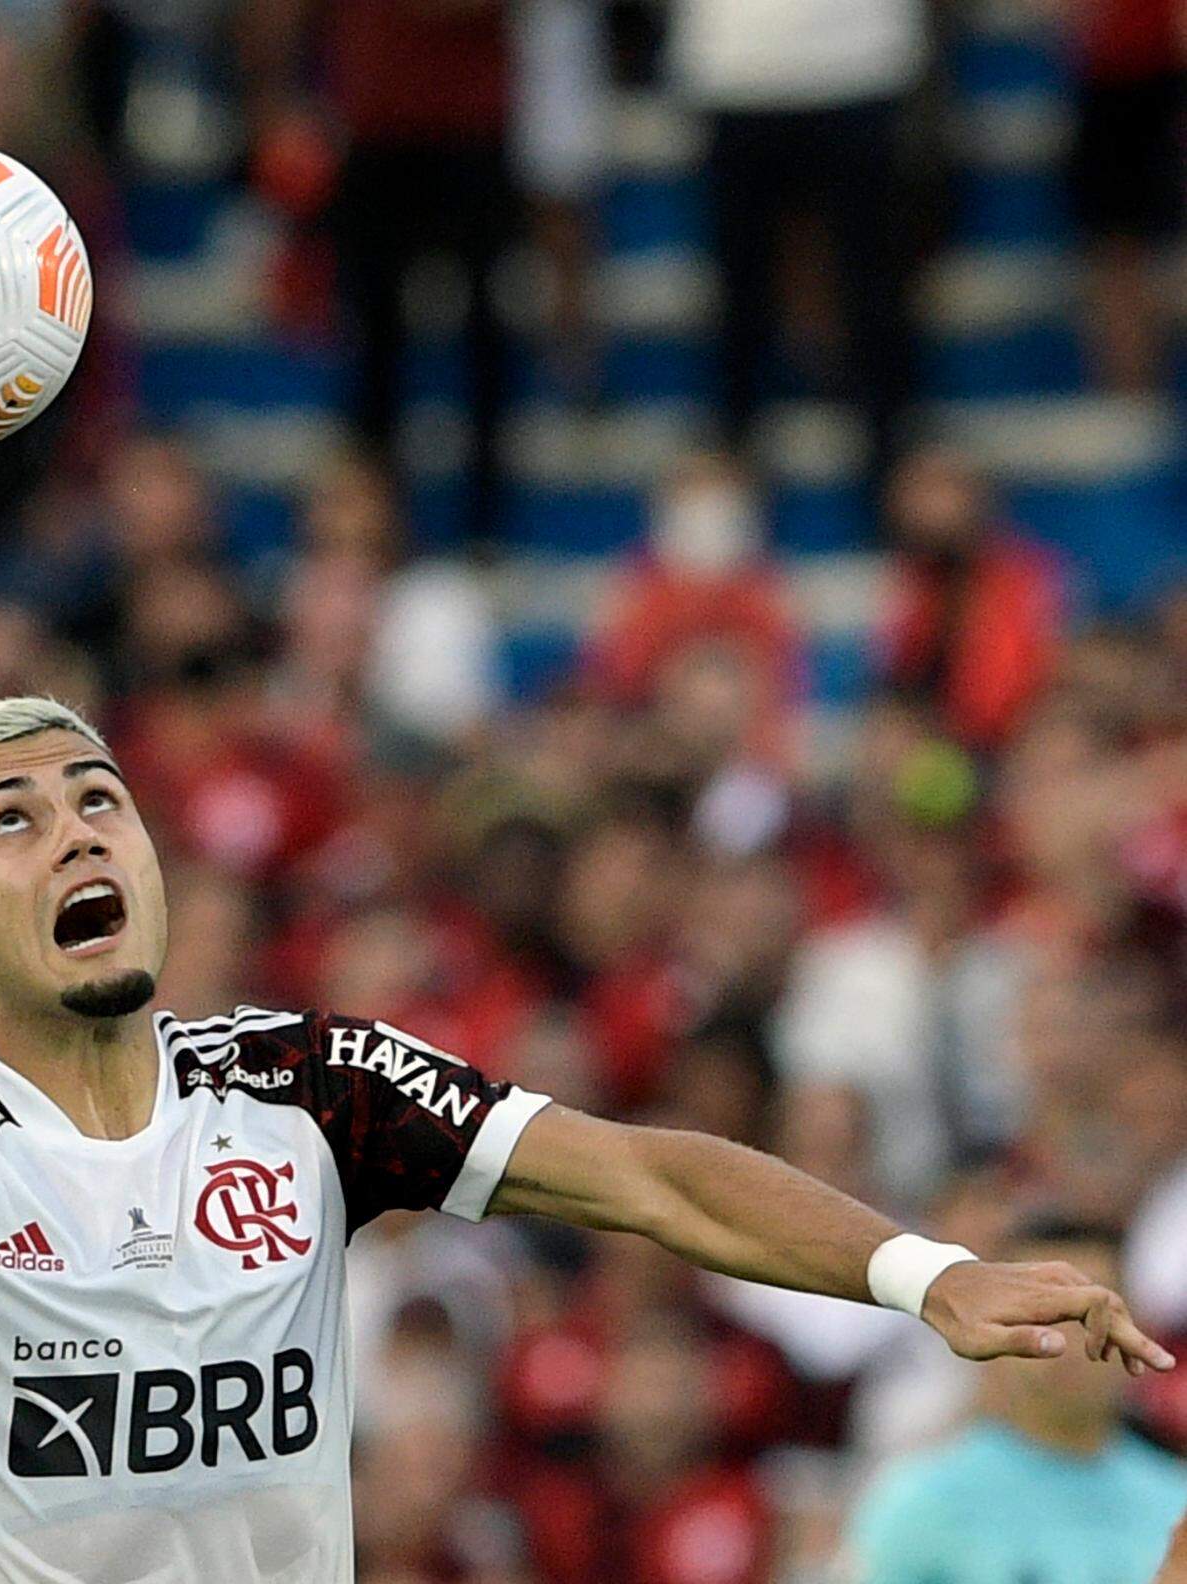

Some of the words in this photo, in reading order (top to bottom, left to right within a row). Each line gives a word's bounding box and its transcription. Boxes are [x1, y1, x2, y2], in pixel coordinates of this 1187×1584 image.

[325, 1027, 480, 1127] HAVAN
[14, 1335, 124, 1362] banco
[127, 1347, 319, 1475] BRB
